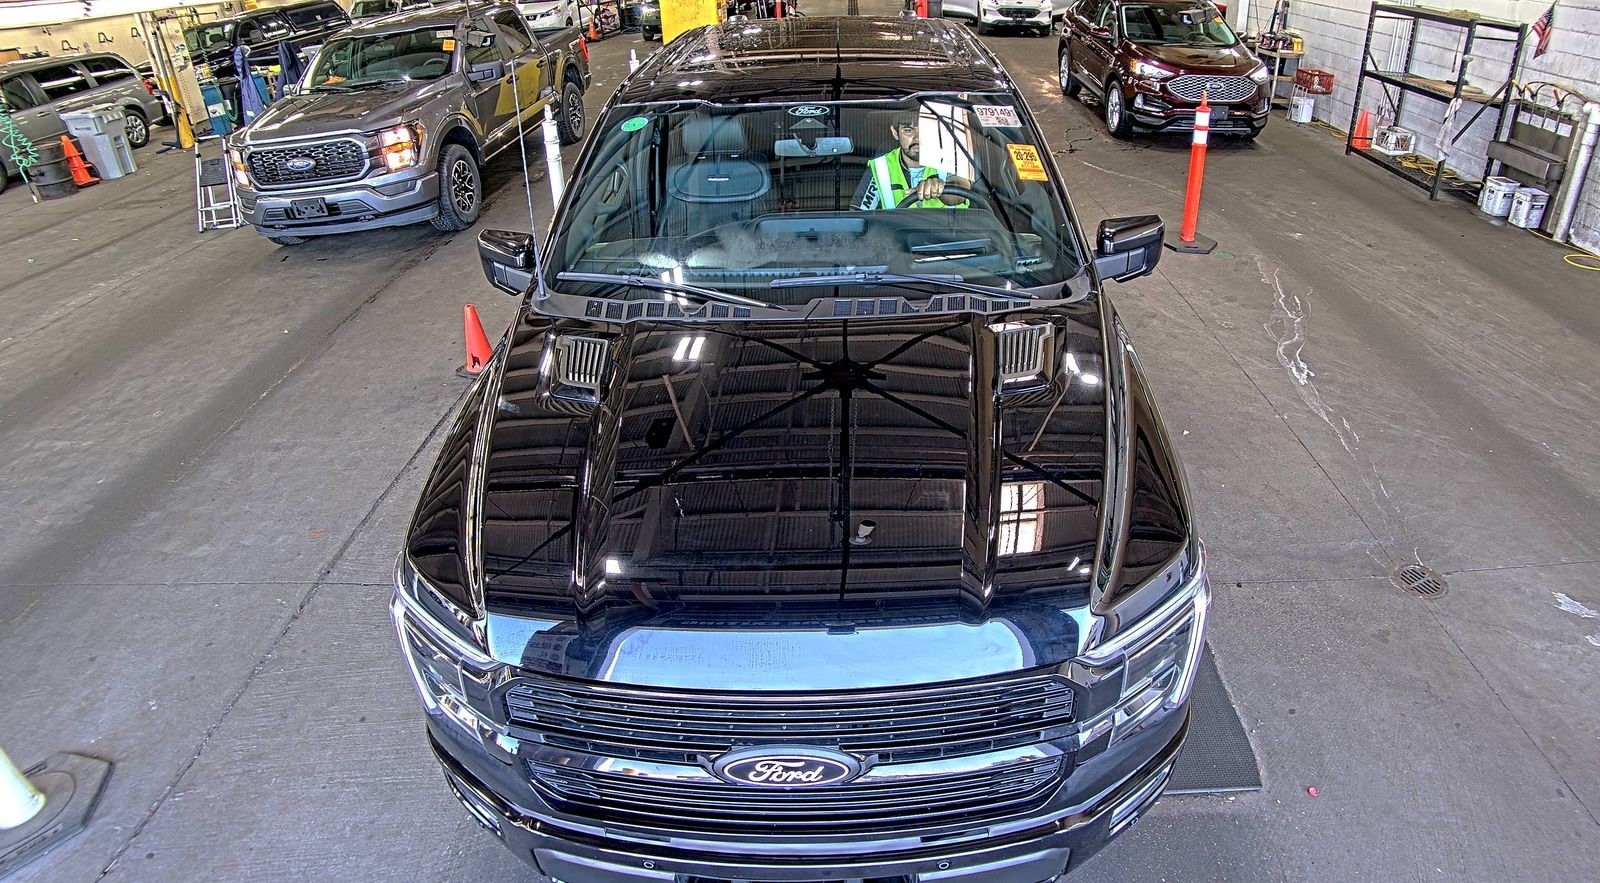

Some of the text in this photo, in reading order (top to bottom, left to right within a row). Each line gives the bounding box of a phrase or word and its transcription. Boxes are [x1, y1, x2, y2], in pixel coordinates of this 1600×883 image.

[796, 105, 822, 115] Ford
[977, 107, 1016, 117] 9791491
[749, 760, 825, 782] Ford
